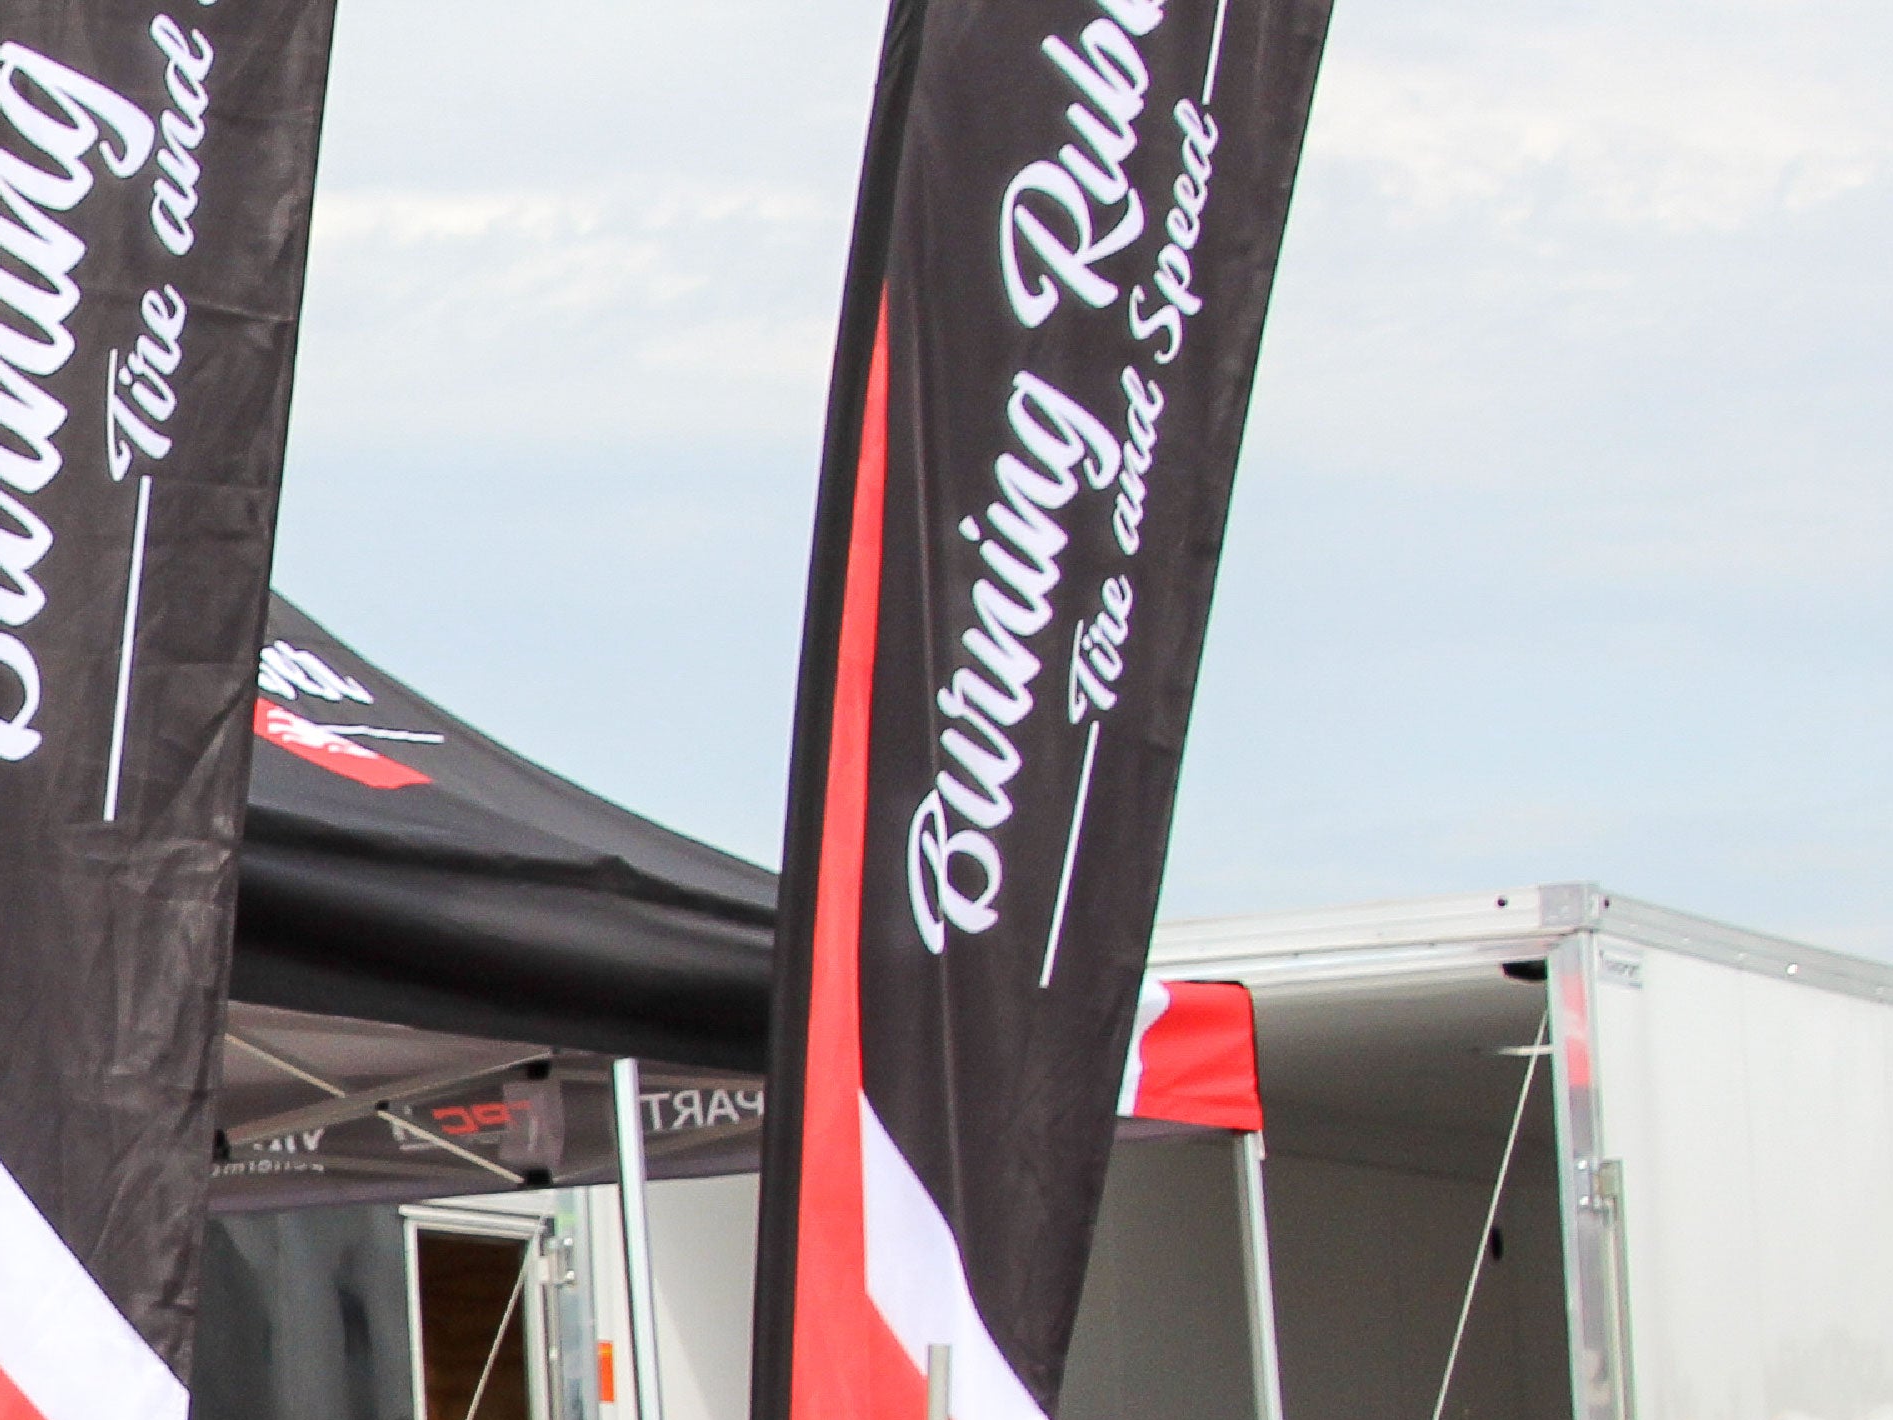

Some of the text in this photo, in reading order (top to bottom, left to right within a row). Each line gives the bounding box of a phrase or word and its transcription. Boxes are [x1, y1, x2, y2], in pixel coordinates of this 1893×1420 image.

[107, 13, 214, 482] Tire and
[1069, 99, 1220, 725] Tire and Speed
[907, 370, 1123, 955] Burning
